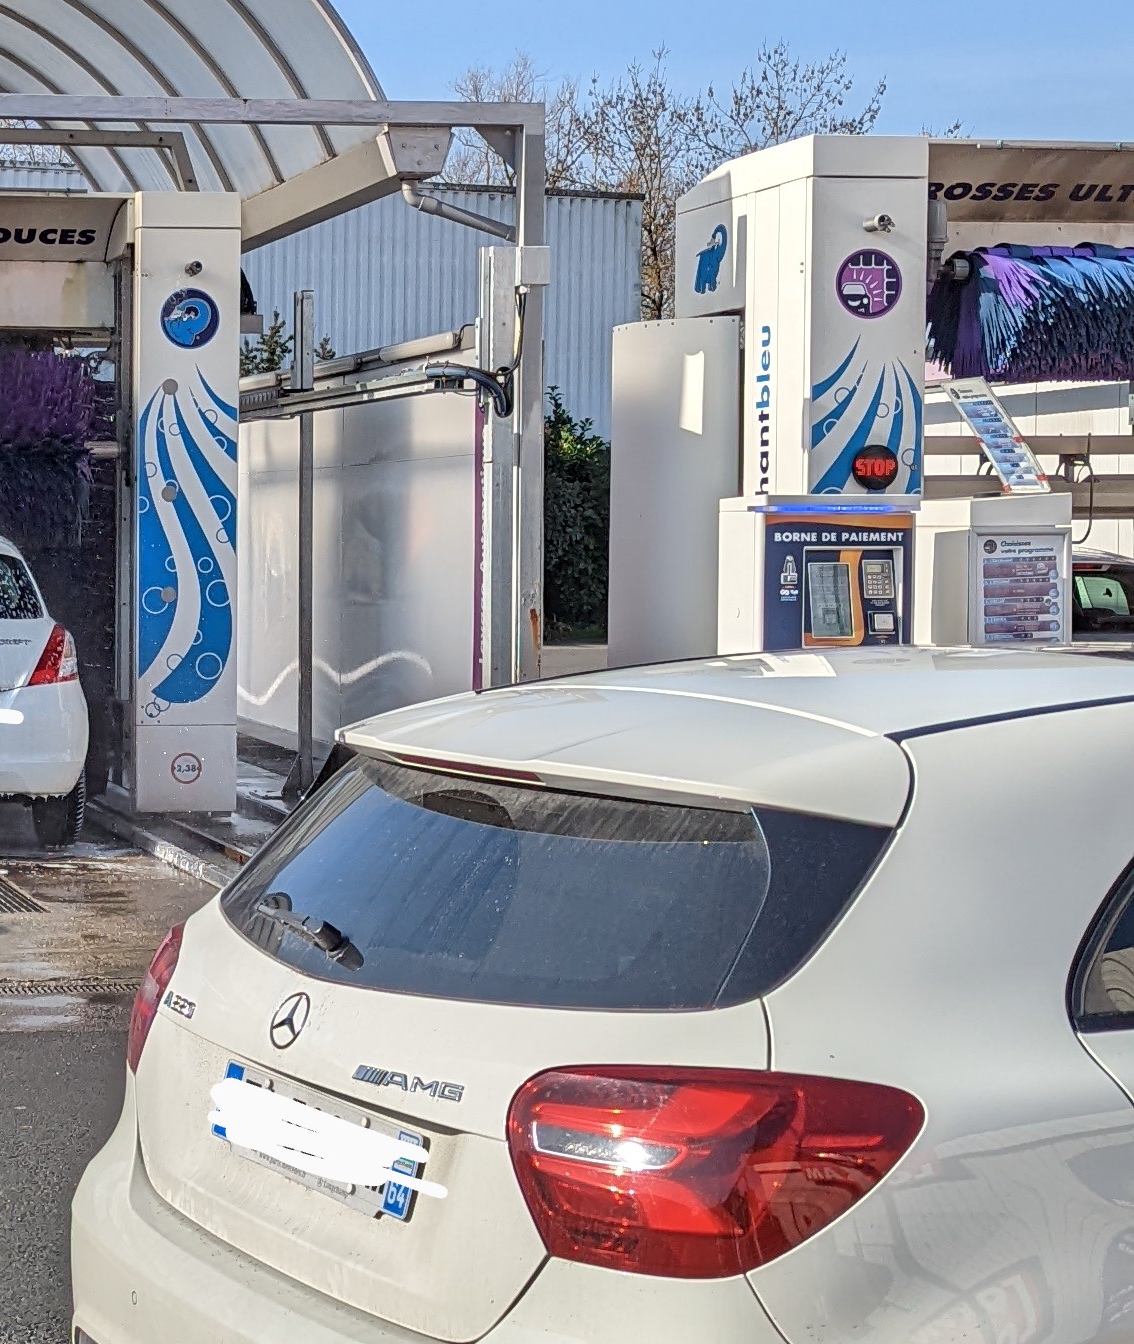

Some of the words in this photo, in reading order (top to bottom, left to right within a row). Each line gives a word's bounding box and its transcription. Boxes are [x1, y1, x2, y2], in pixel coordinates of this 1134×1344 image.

[856, 459, 896, 475] STOP
[774, 532, 817, 542] BORNE
[822, 532, 837, 542] DE
[841, 532, 904, 542] PAIEMENT
[381, 1069, 465, 1103] AMG
